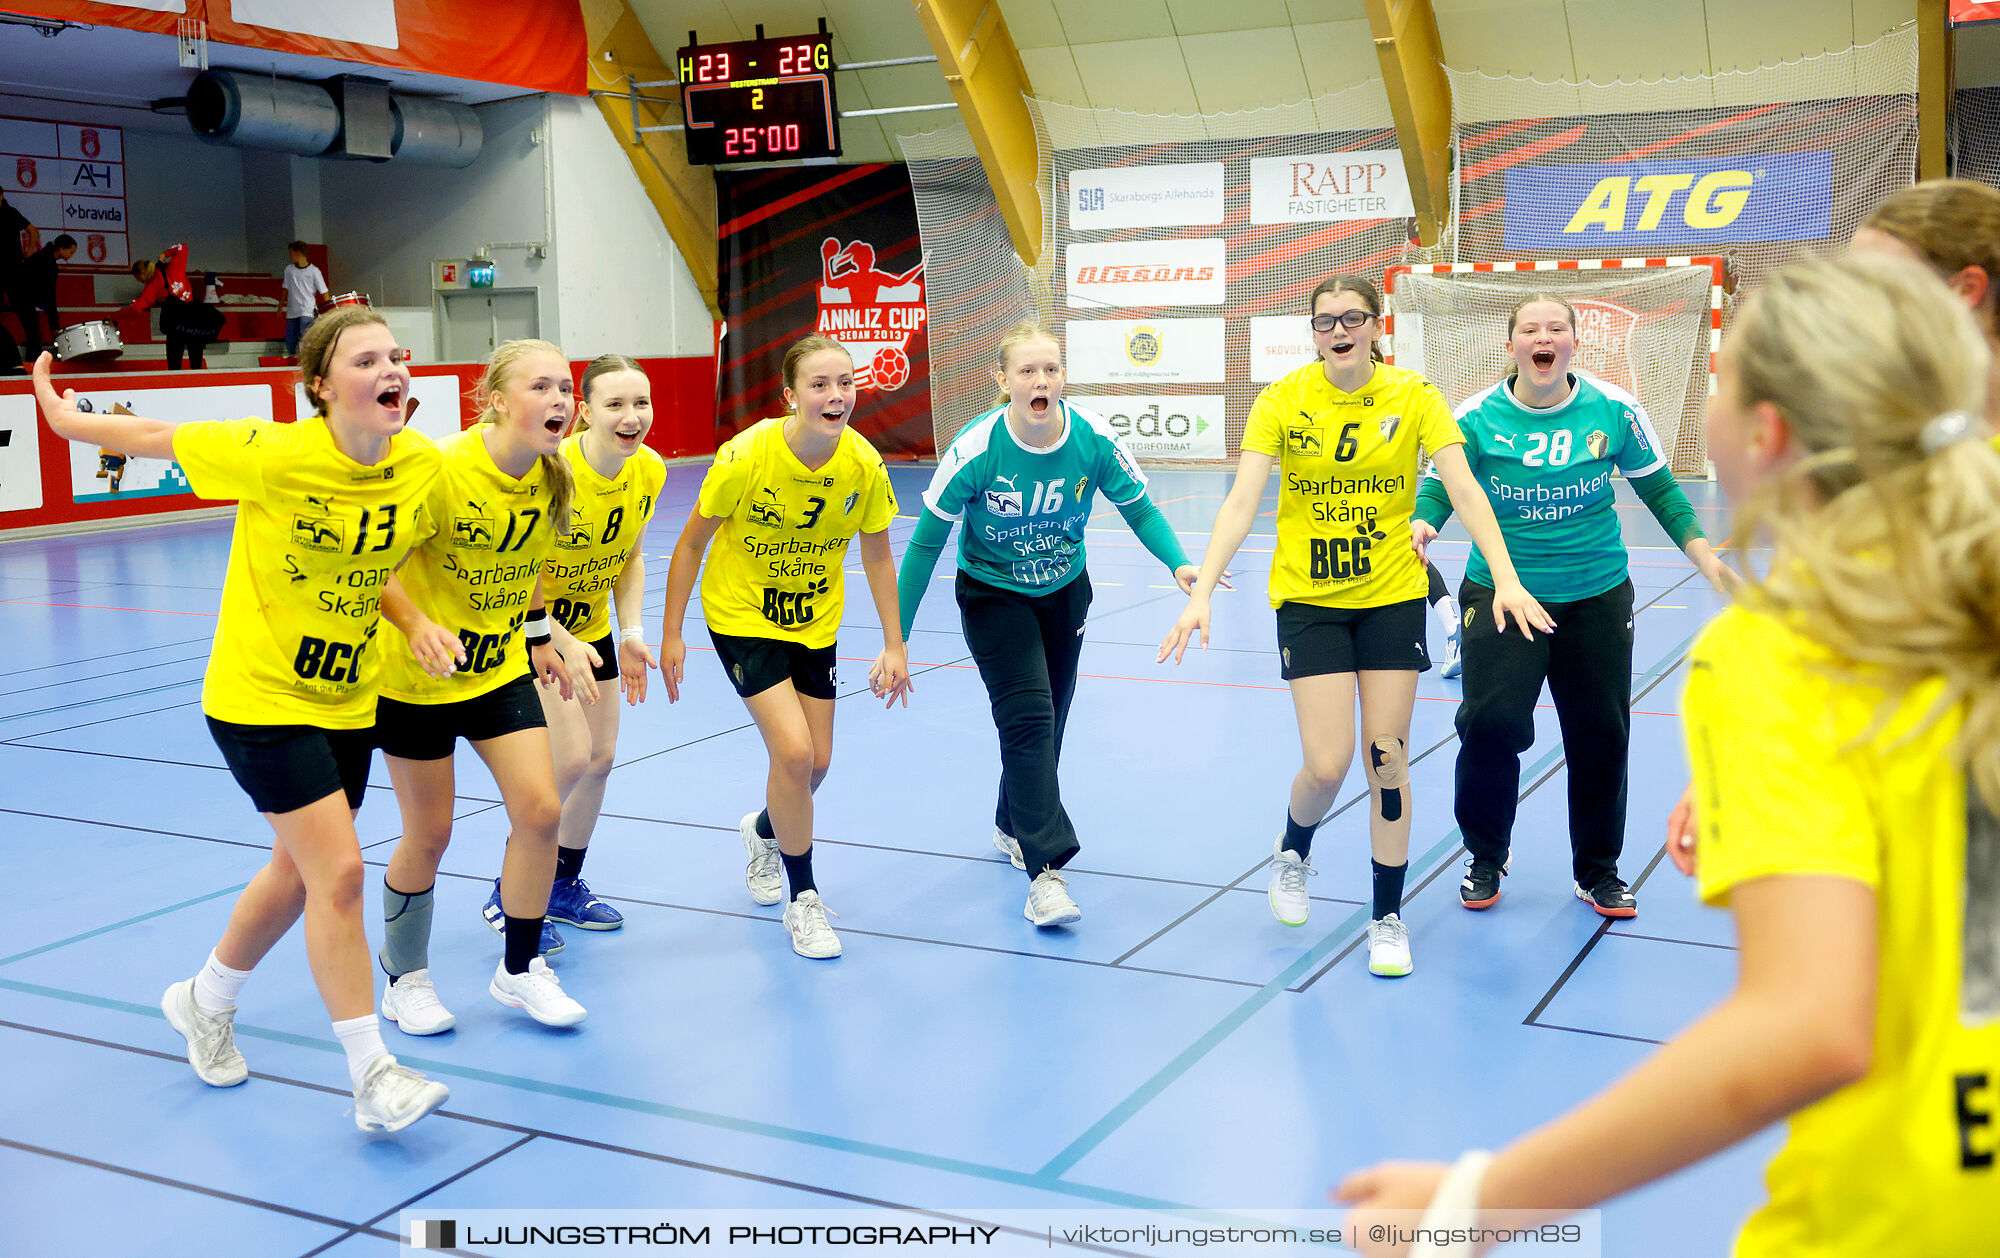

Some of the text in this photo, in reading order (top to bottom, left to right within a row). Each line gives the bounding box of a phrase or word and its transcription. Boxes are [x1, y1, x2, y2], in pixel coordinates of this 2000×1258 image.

[680, 57, 694, 83] H
[698, 53, 730, 82] 23
[779, 45, 812, 74] 22
[814, 43, 830, 70] G
[751, 88, 764, 110] 2
[1289, 162, 1387, 197] RAPP
[1079, 188, 1104, 211] SLA
[1109, 187, 1214, 204] Skaraborgs Allehanda
[1288, 197, 1387, 215] FASTIGHETER
[78, 204, 122, 222] bravida
[819, 308, 926, 331] ANNLIZ CUP
[840, 330, 902, 341] SEDAN 2013
[1334, 420, 1362, 462] 6
[1522, 429, 1573, 467] 28
[1288, 472, 1405, 496] Sparbanken
[1490, 471, 1608, 502] Sparbanken
[1028, 478, 1066, 516] 16
[796, 495, 827, 529] 3
[1312, 500, 1378, 522] Skåne
[351, 504, 397, 555] 13
[496, 509, 540, 552] 17
[601, 505, 624, 544] 8
[744, 536, 850, 558] Sparbanken
[1310, 536, 1372, 579] BCC
[768, 557, 825, 577] Skåne
[469, 587, 527, 611] Skåne
